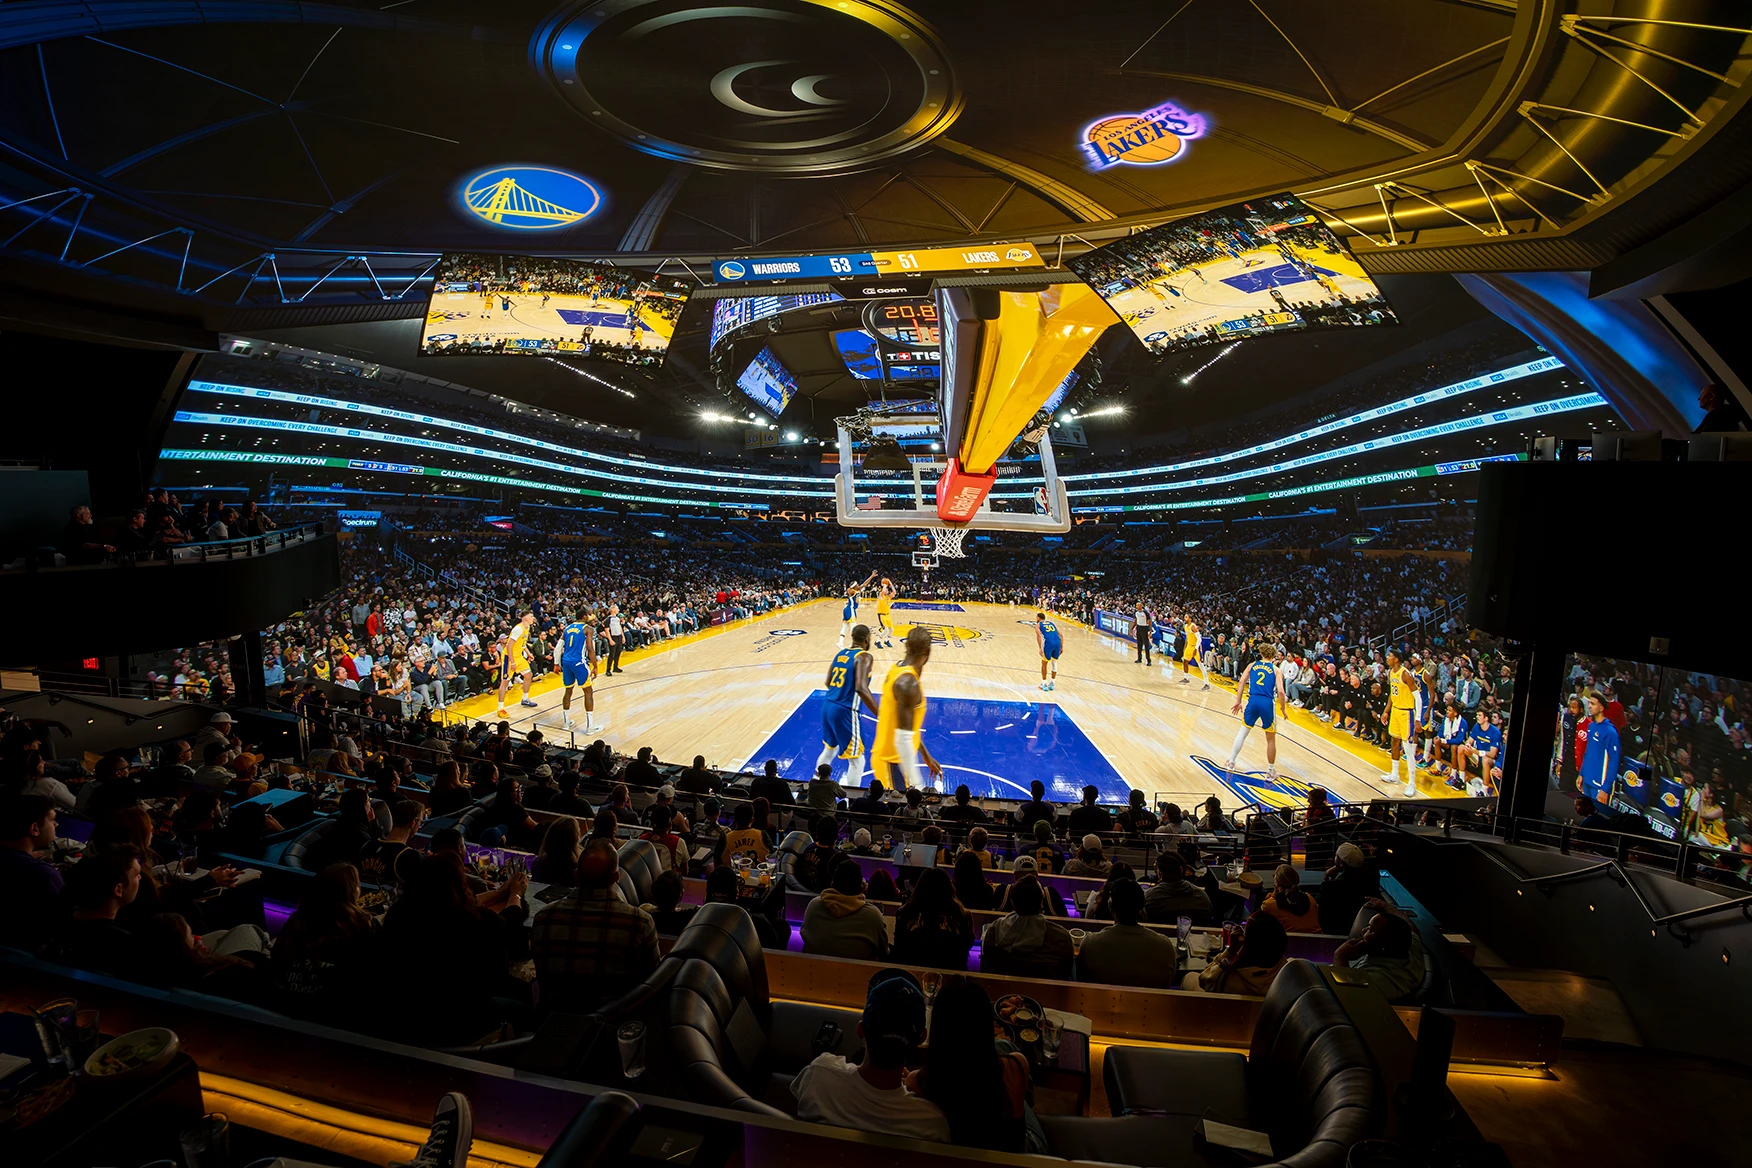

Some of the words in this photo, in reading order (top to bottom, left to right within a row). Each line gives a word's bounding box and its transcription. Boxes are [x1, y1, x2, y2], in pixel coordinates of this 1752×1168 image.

[1103, 130, 1122, 140] LOS
[1125, 107, 1172, 132] ANGELES
[1090, 113, 1198, 166] LAKERS
[752, 263, 800, 275] WARRIORS
[829, 257, 851, 273] 53
[897, 254, 918, 269] 51
[962, 251, 1000, 263] LAKERS
[884, 305, 936, 319] 20.8
[1234, 320, 1246, 329] 53
[1527, 362, 1542, 372] KEEP
[1543, 360, 1553, 368] ON
[199, 384, 215, 392] KEEP
[1444, 387, 1457, 395] KEEP
[1533, 405, 1549, 414] KEEP
[1550, 402, 1560, 411] ON
[219, 416, 236, 424] KEEP
[248, 418, 287, 429] OVERCOMING
[287, 421, 306, 431] EVERY
[306, 424, 338, 434] CHALLENGE
[1391, 435, 1403, 443] KEEP
[1440, 423, 1456, 433] EVERY
[1456, 418, 1485, 429] CHALLENGE
[252, 453, 327, 466] DESTINATION
[441, 470, 489, 481] CALIFORNIA'S
[498, 477, 546, 489] ENTERTAINMENT
[547, 484, 581, 494] DESTINATION
[1269, 488, 1306, 499] CALIFORNIA'S
[1314, 476, 1366, 492] ENTERTAINMENT
[1367, 469, 1417, 483] DESTINATION
[1043, 624, 1056, 632] 30
[830, 667, 847, 688] 23
[1256, 671, 1265, 686] 2
[734, 838, 755, 848] JAMES
[1036, 847, 1053, 874] 6
